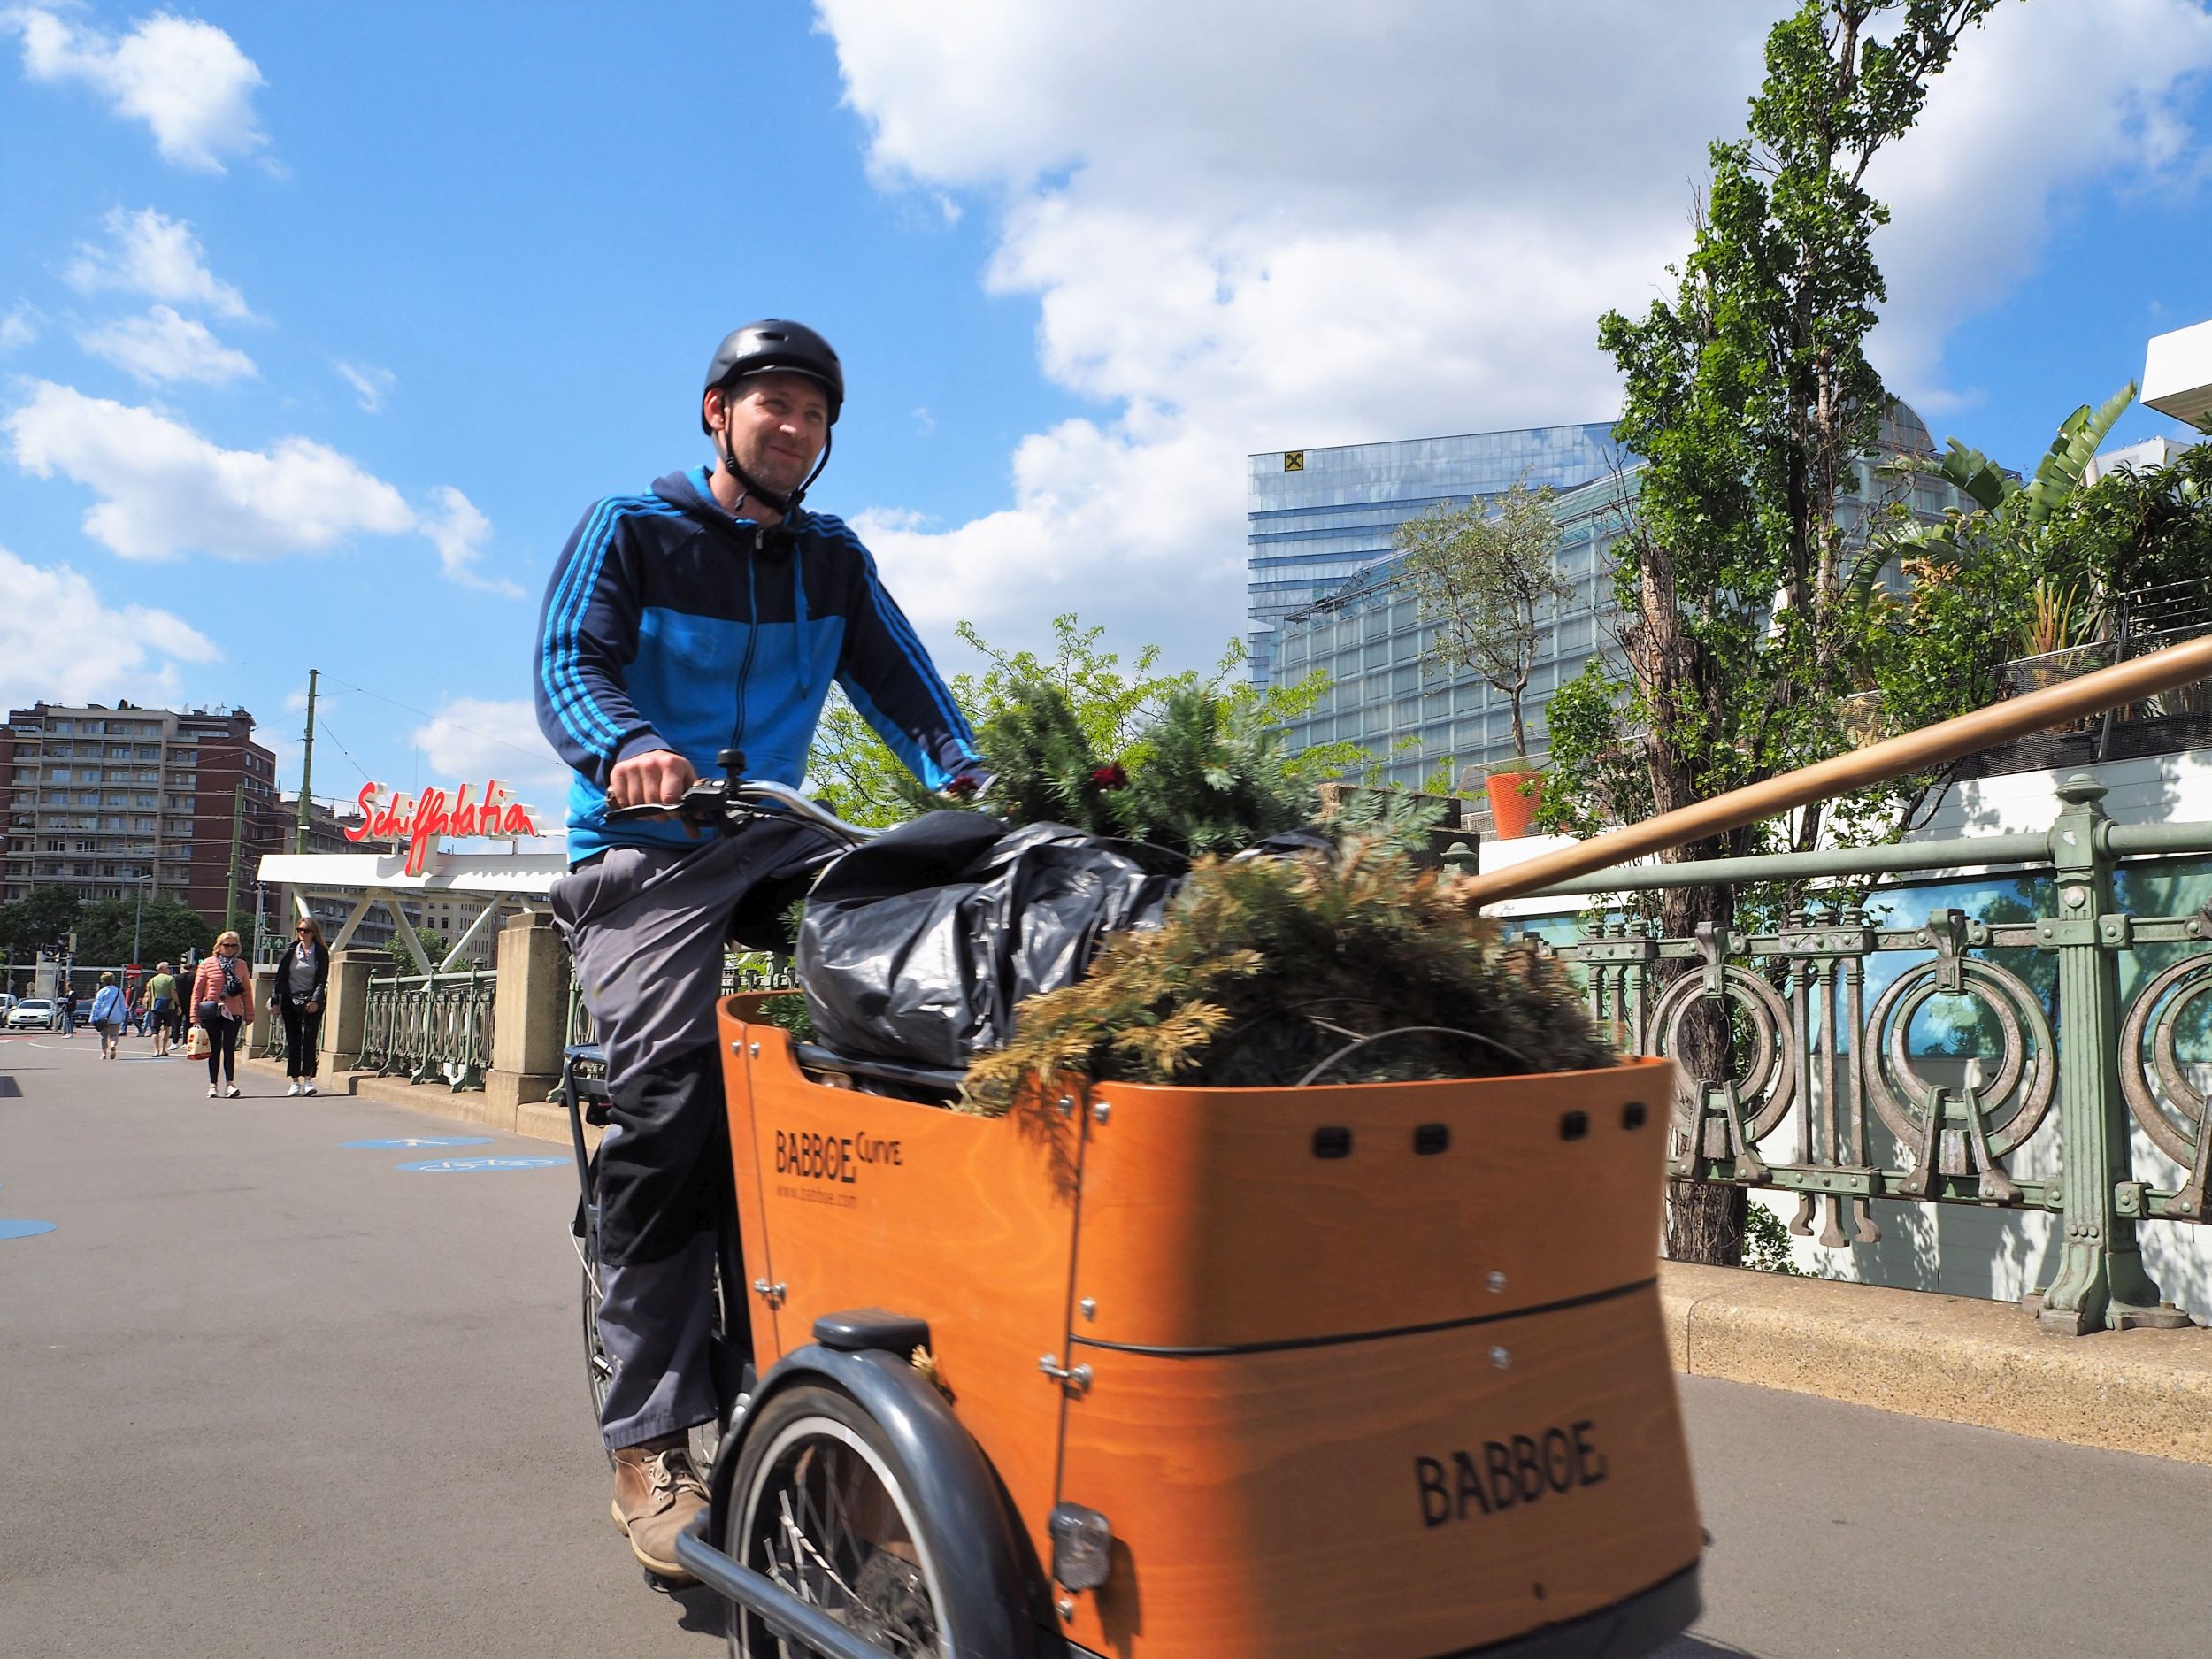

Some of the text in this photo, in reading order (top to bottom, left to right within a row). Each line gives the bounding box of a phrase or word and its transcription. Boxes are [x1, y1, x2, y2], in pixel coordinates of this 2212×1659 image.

[344, 779, 537, 876] Schiffstation
[776, 1130, 856, 1183] BABBOE
[1414, 1419, 1608, 1528] BABBOE
